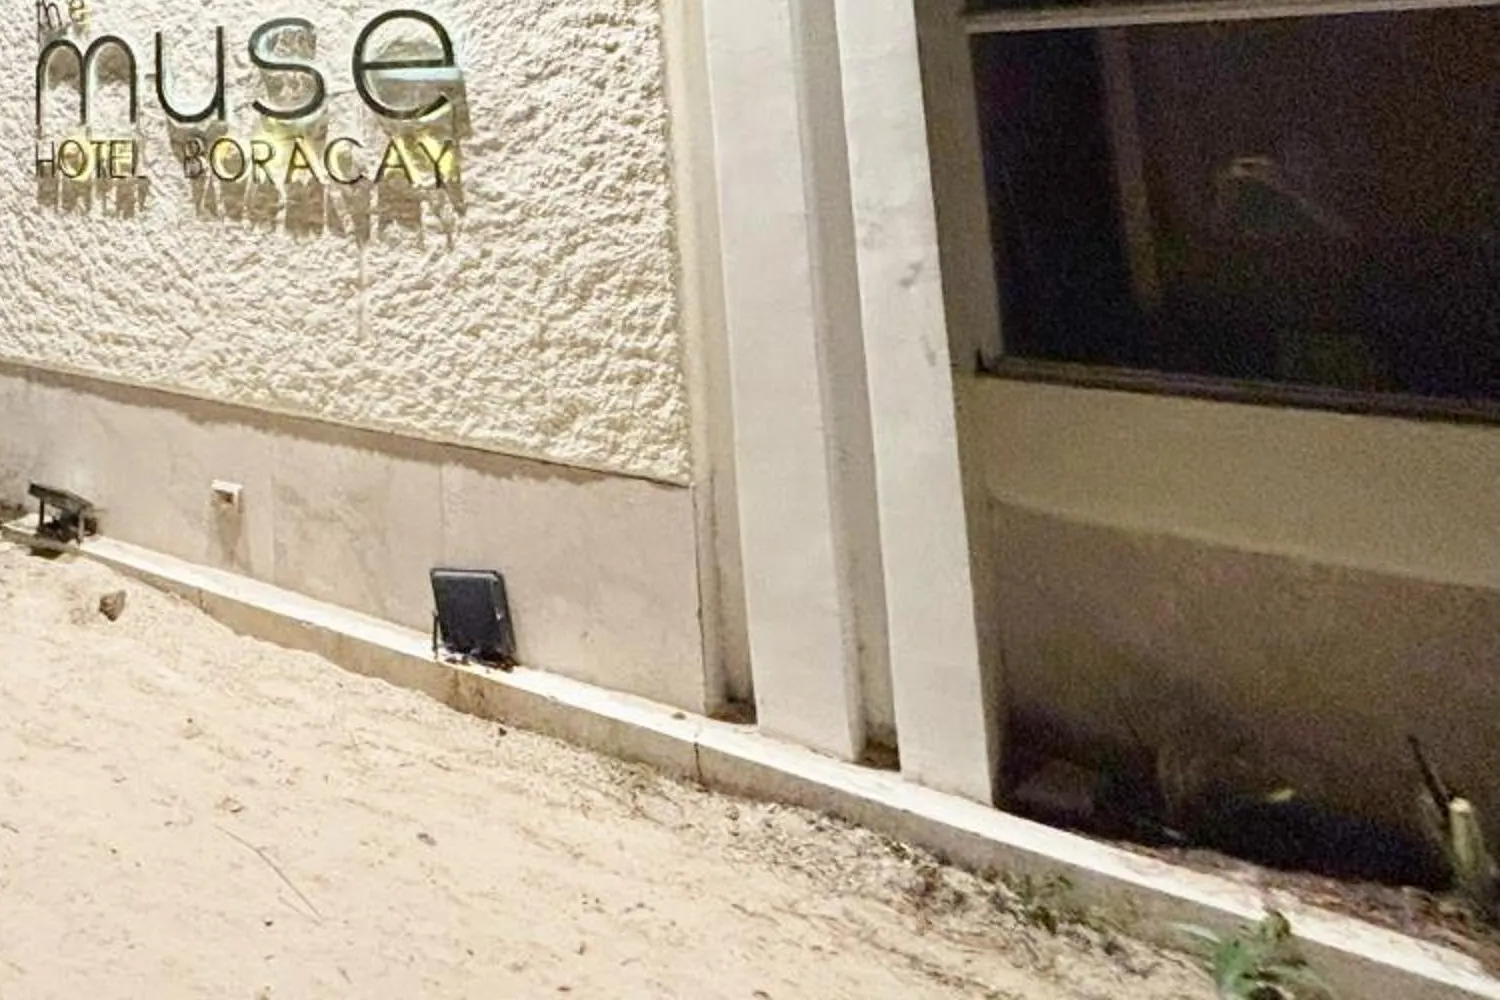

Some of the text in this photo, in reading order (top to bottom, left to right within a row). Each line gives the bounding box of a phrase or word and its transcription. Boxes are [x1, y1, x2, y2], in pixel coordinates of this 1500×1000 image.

[35, 9, 455, 125] muse
[35, 136, 454, 189] HOTEL BORACAY
